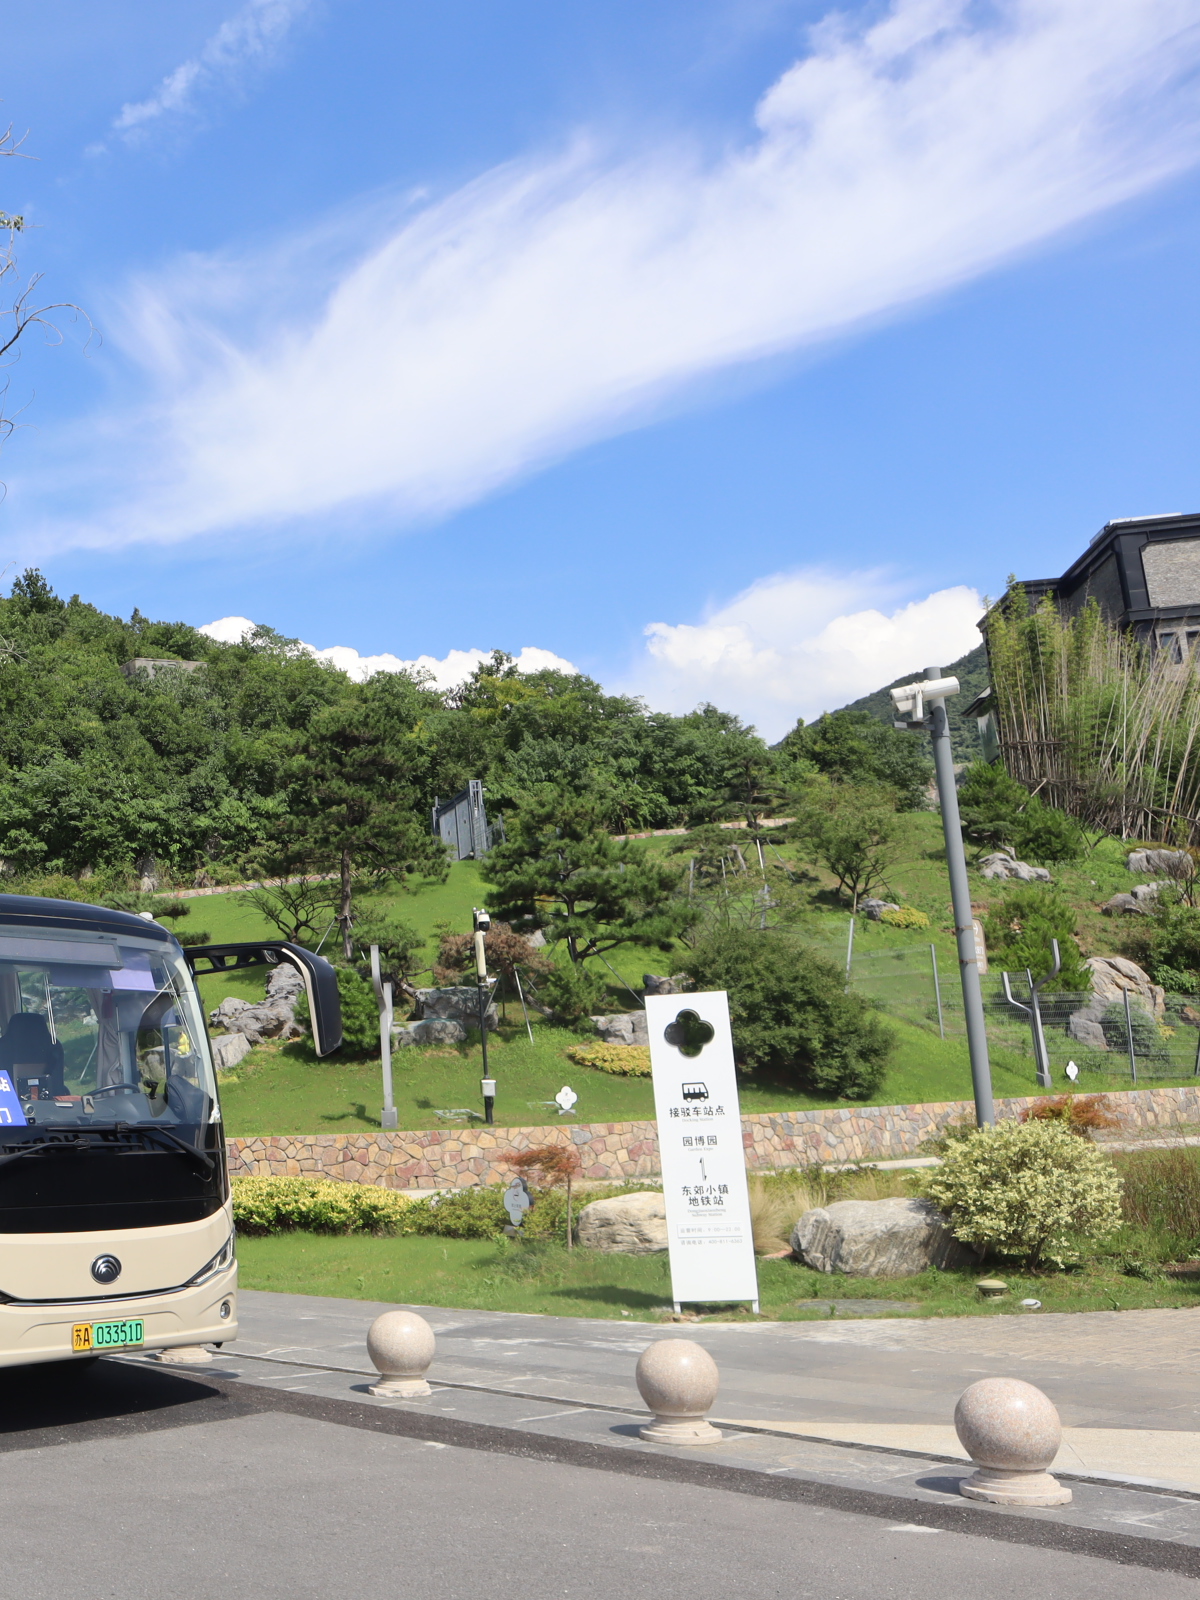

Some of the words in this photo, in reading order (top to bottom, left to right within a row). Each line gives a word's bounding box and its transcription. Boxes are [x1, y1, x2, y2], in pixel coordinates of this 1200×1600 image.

[669, 1105, 726, 1118] 接驳车站点
[682, 1135, 718, 1147] 园博园
[681, 1184, 729, 1196] 东郊小镇
[688, 1195, 724, 1207] 地铁站
